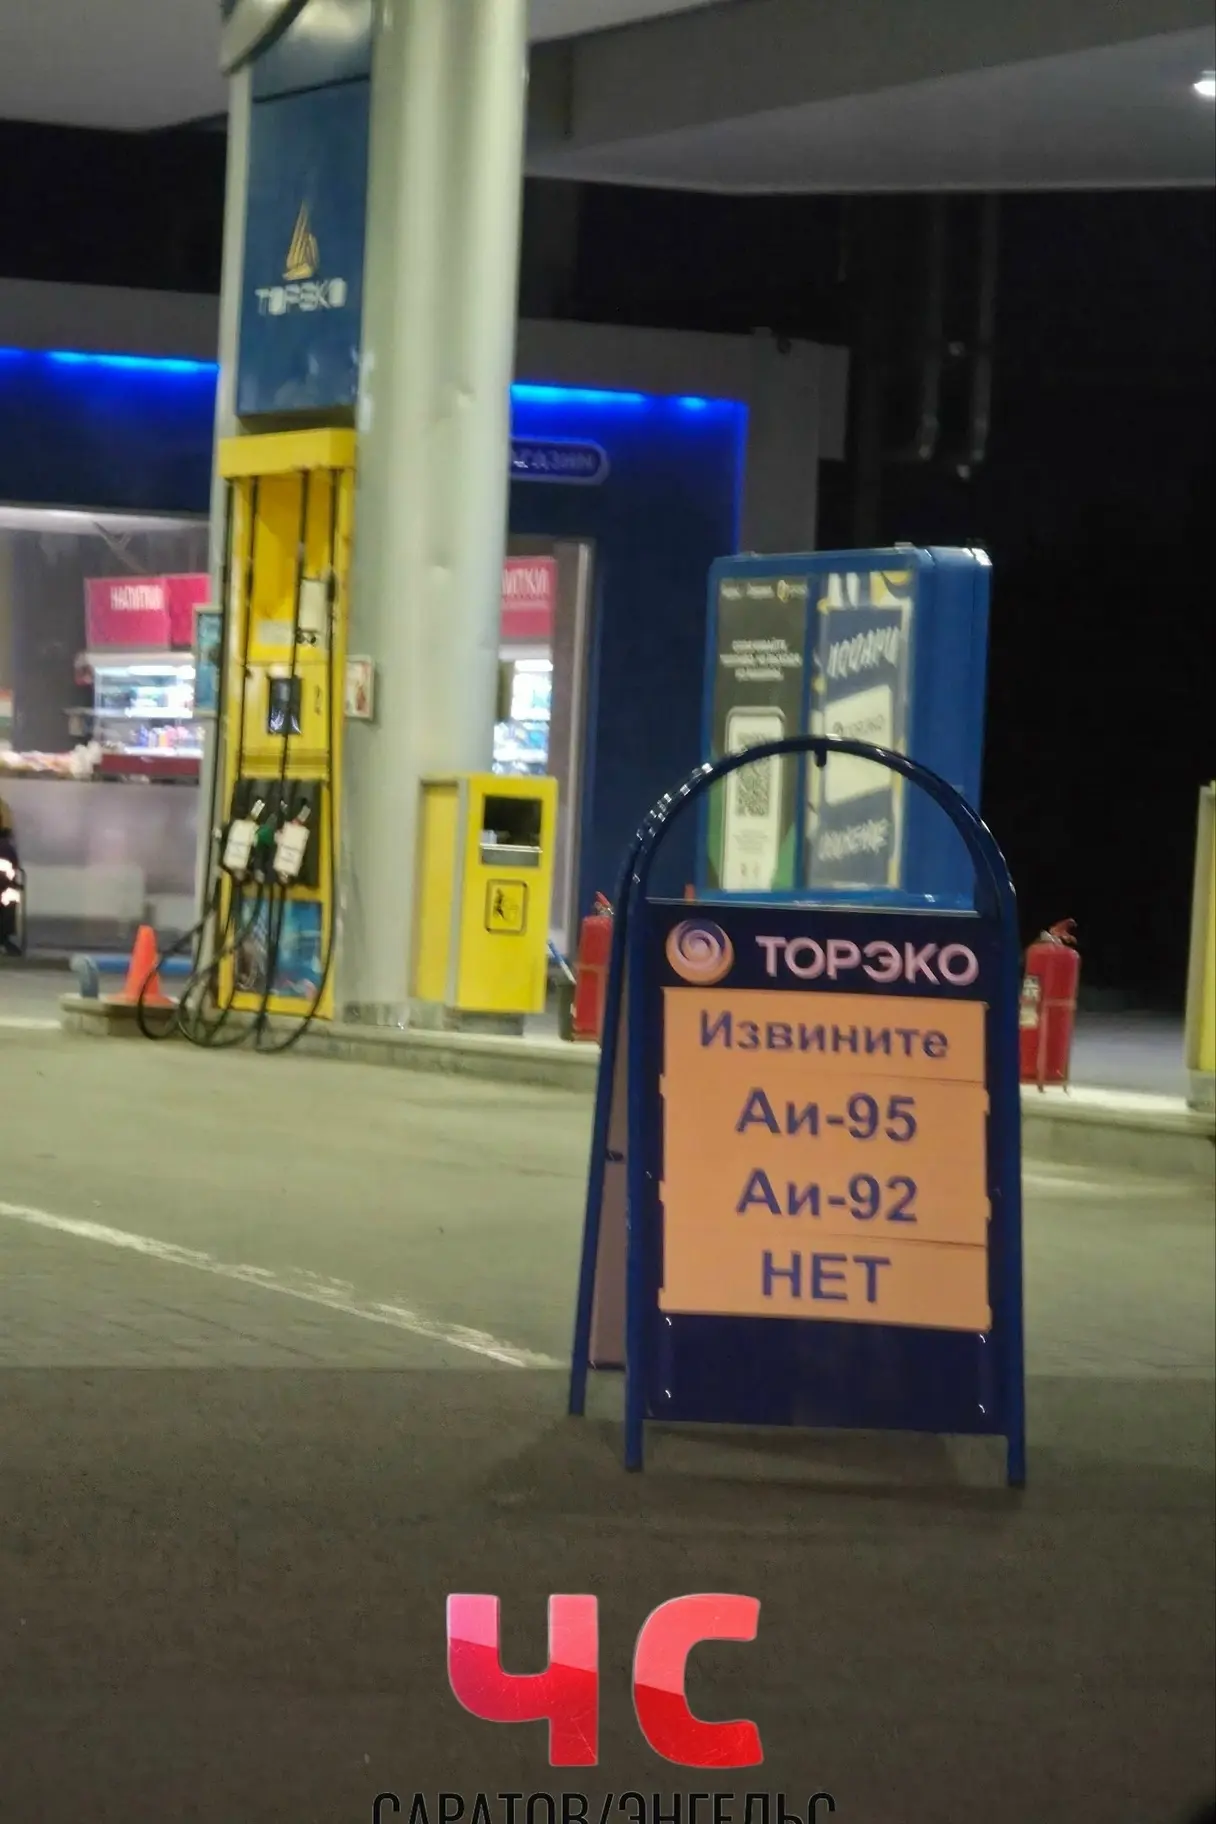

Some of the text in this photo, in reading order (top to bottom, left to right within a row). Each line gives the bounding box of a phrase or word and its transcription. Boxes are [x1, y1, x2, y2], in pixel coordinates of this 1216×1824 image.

[756, 935, 980, 985] ТОРЭКО
[700, 1010, 949, 1060] Извините
[735, 1087, 918, 1143] Аи-95
[735, 1168, 918, 1224] Аи-92
[761, 1250, 892, 1303] НЕТ
